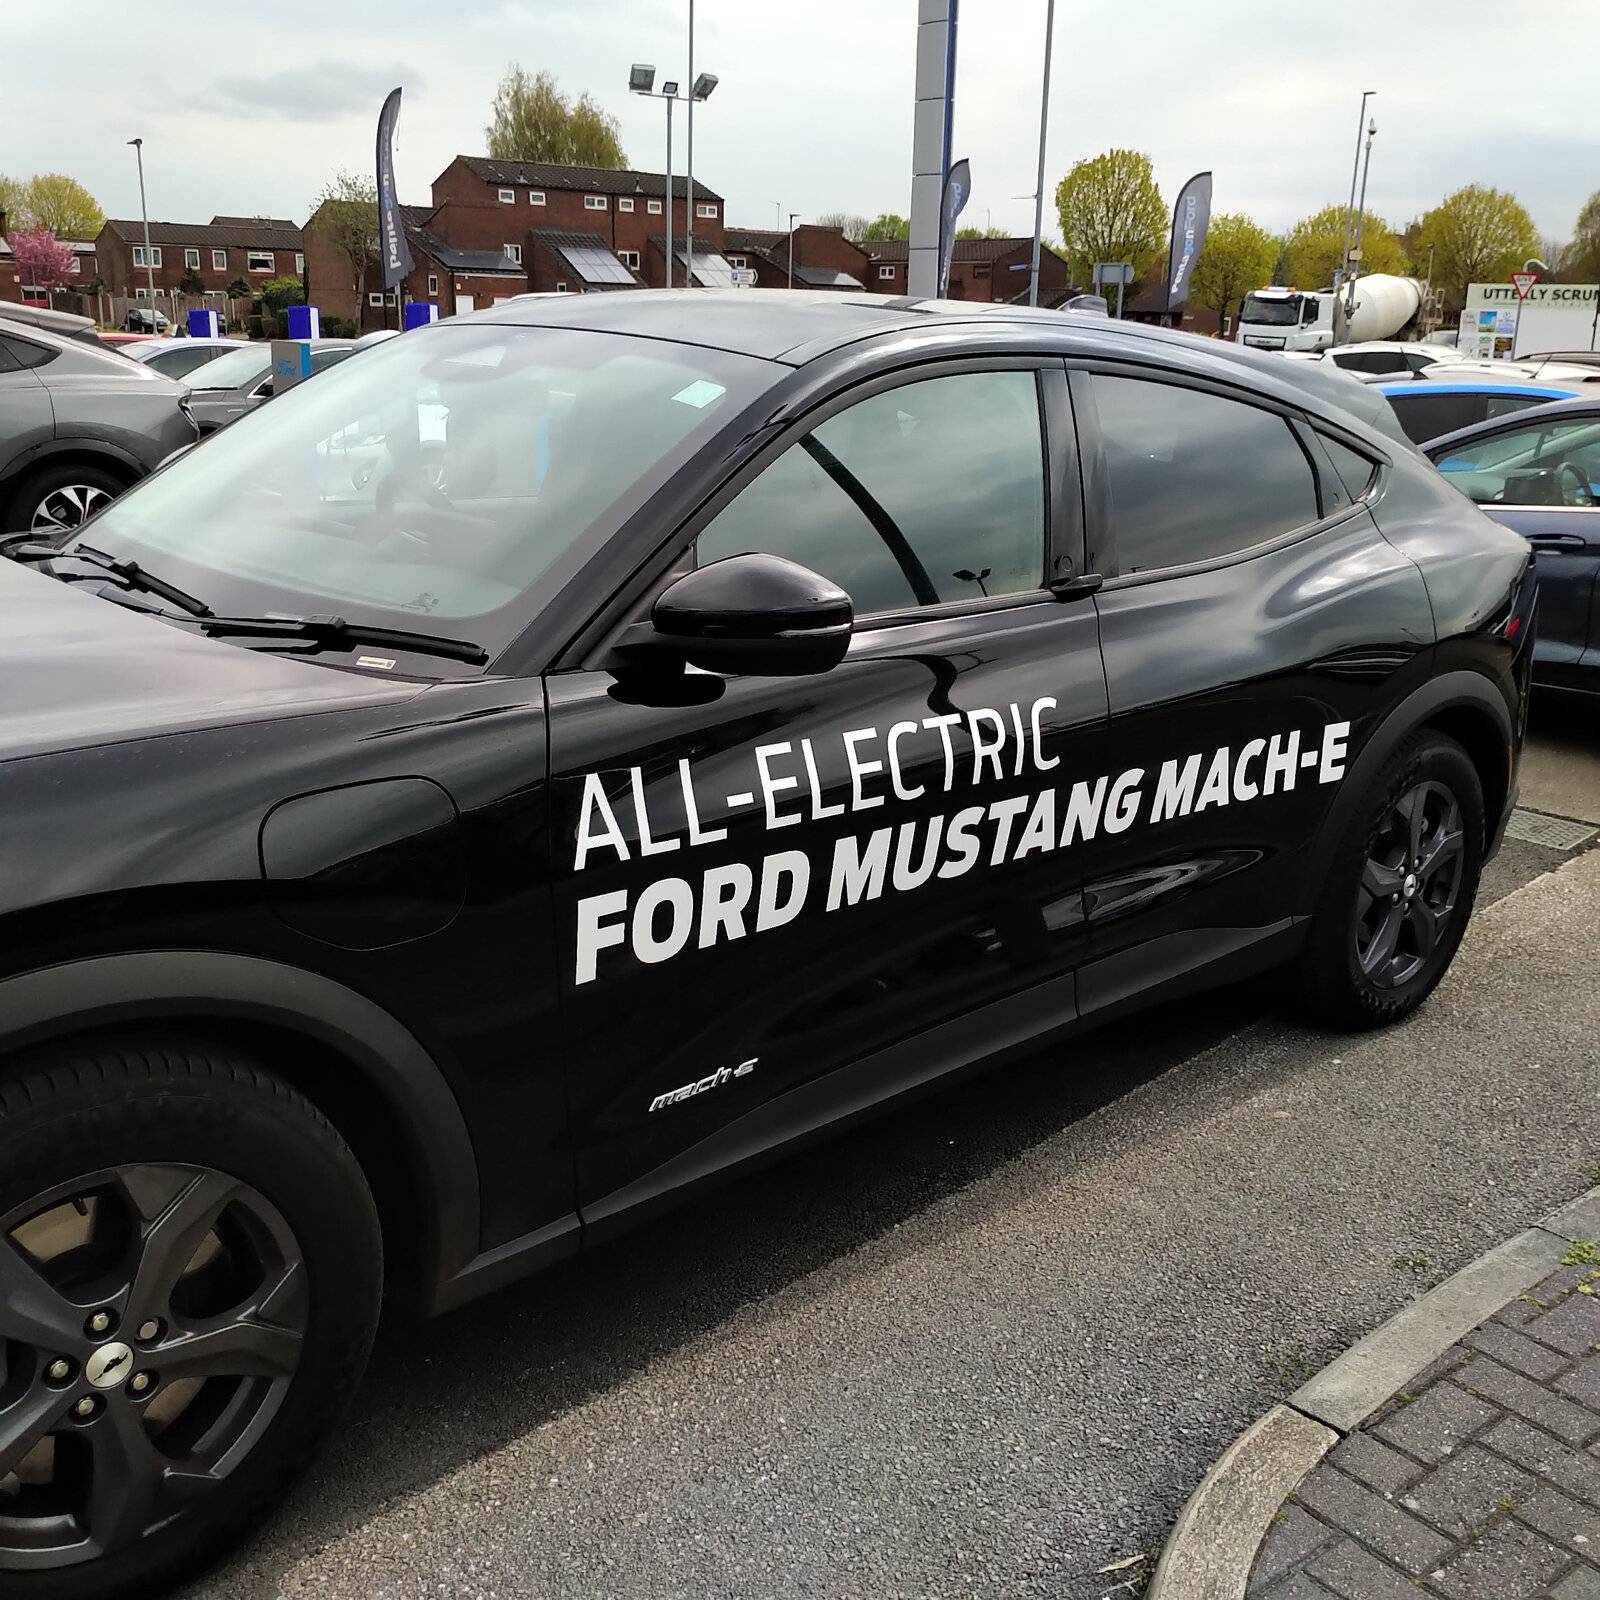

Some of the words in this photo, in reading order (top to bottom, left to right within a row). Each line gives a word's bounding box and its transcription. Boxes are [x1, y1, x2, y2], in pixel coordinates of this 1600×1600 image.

[1483, 288, 1549, 300] UTTELY
[574, 697, 1061, 870] ALL-ELECTRIC
[576, 850, 811, 985] FORD
[825, 768, 1146, 912] MUSTANG
[1149, 721, 1351, 824] MACH-E
